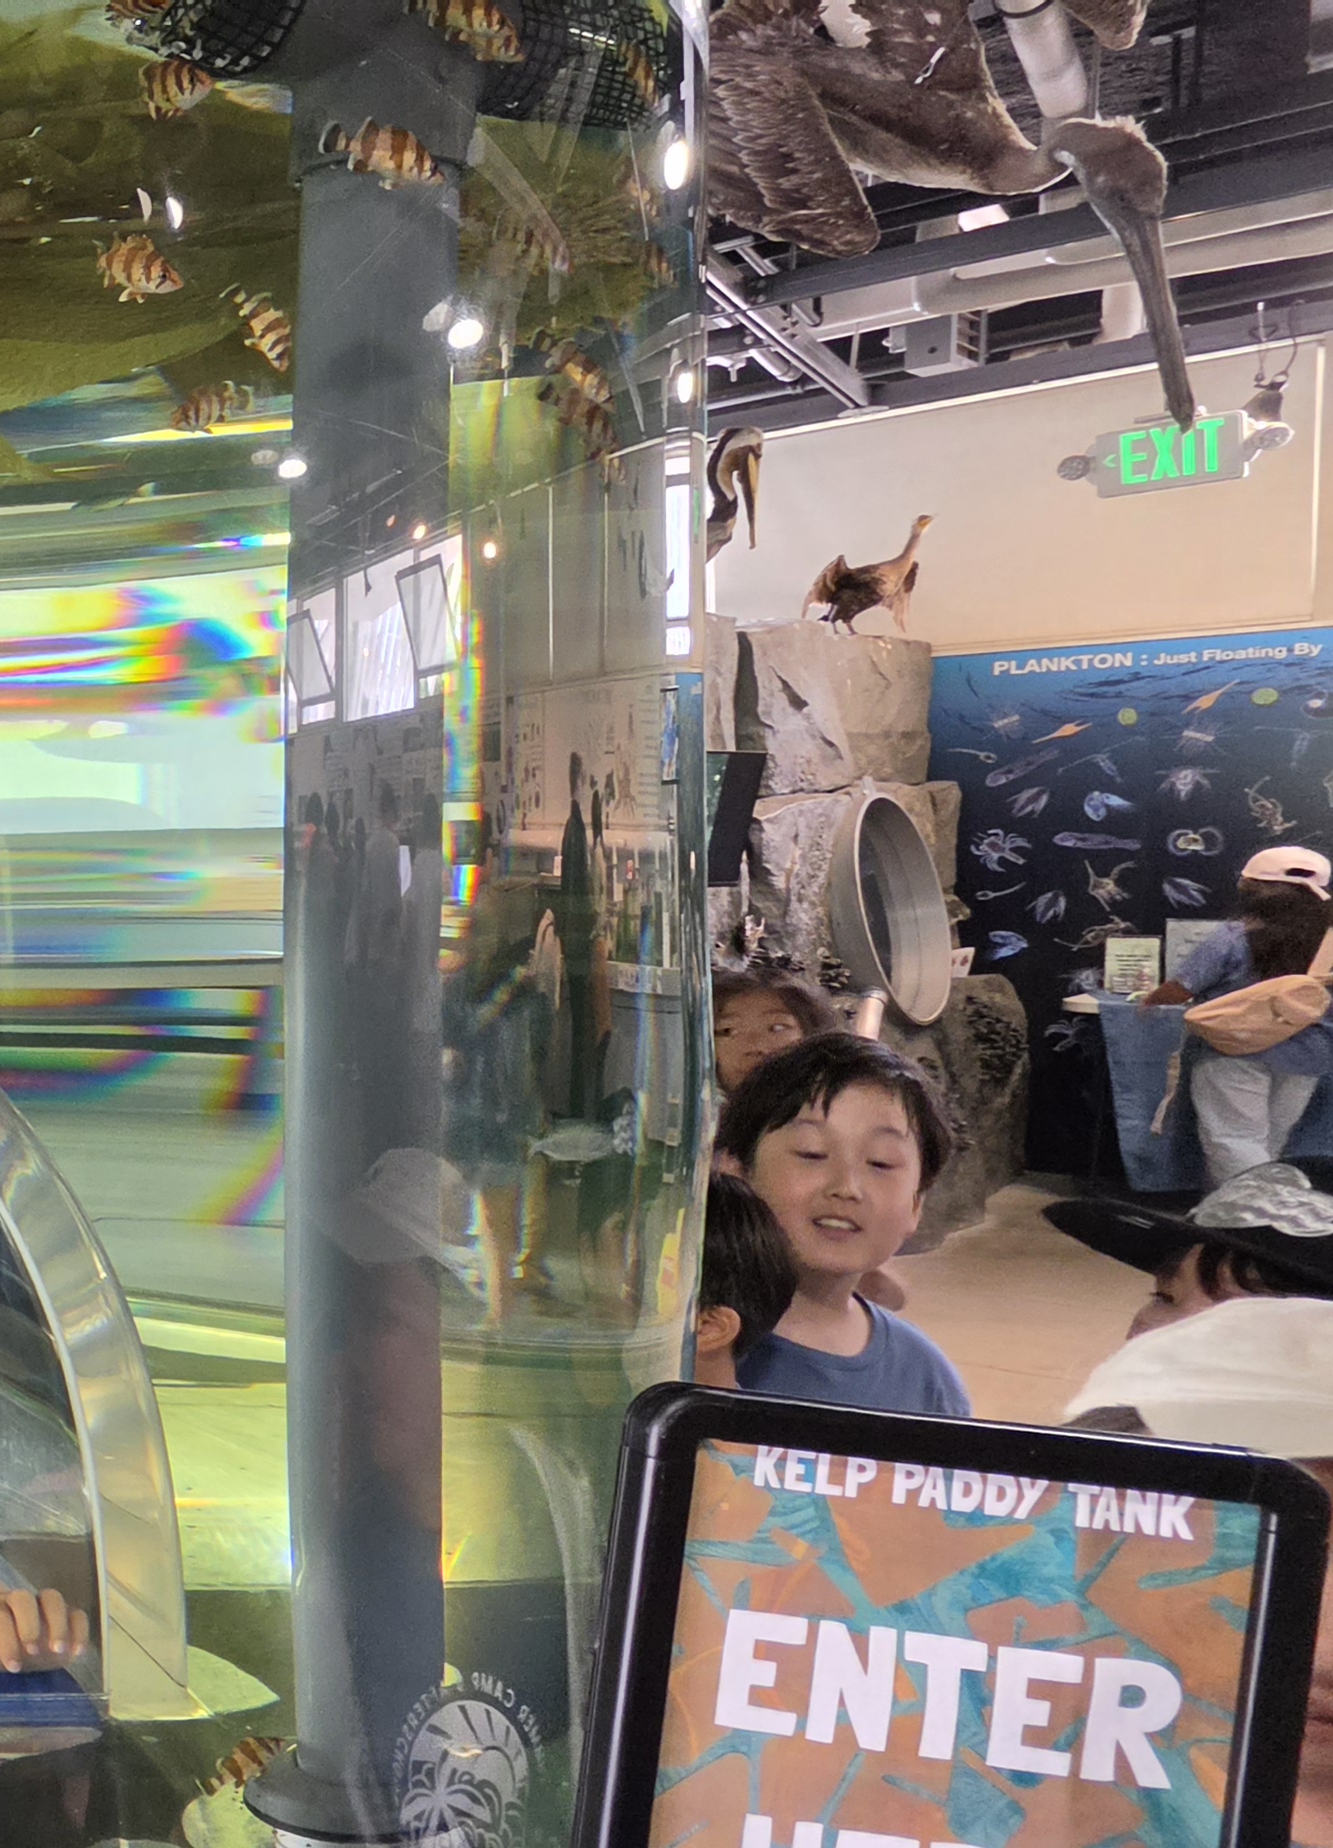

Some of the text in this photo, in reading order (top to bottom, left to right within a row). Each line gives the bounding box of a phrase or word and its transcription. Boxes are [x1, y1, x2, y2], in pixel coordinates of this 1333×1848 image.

[1119, 418, 1225, 485] EXIT
[992, 652, 1133, 676] PLANKTON
[1153, 649, 1198, 666] Just
[1202, 644, 1288, 664] Floating
[1293, 641, 1323, 660] By
[753, 1445, 1196, 1542] KELP PADDY TANK
[714, 1608, 1185, 1791] ENTER
